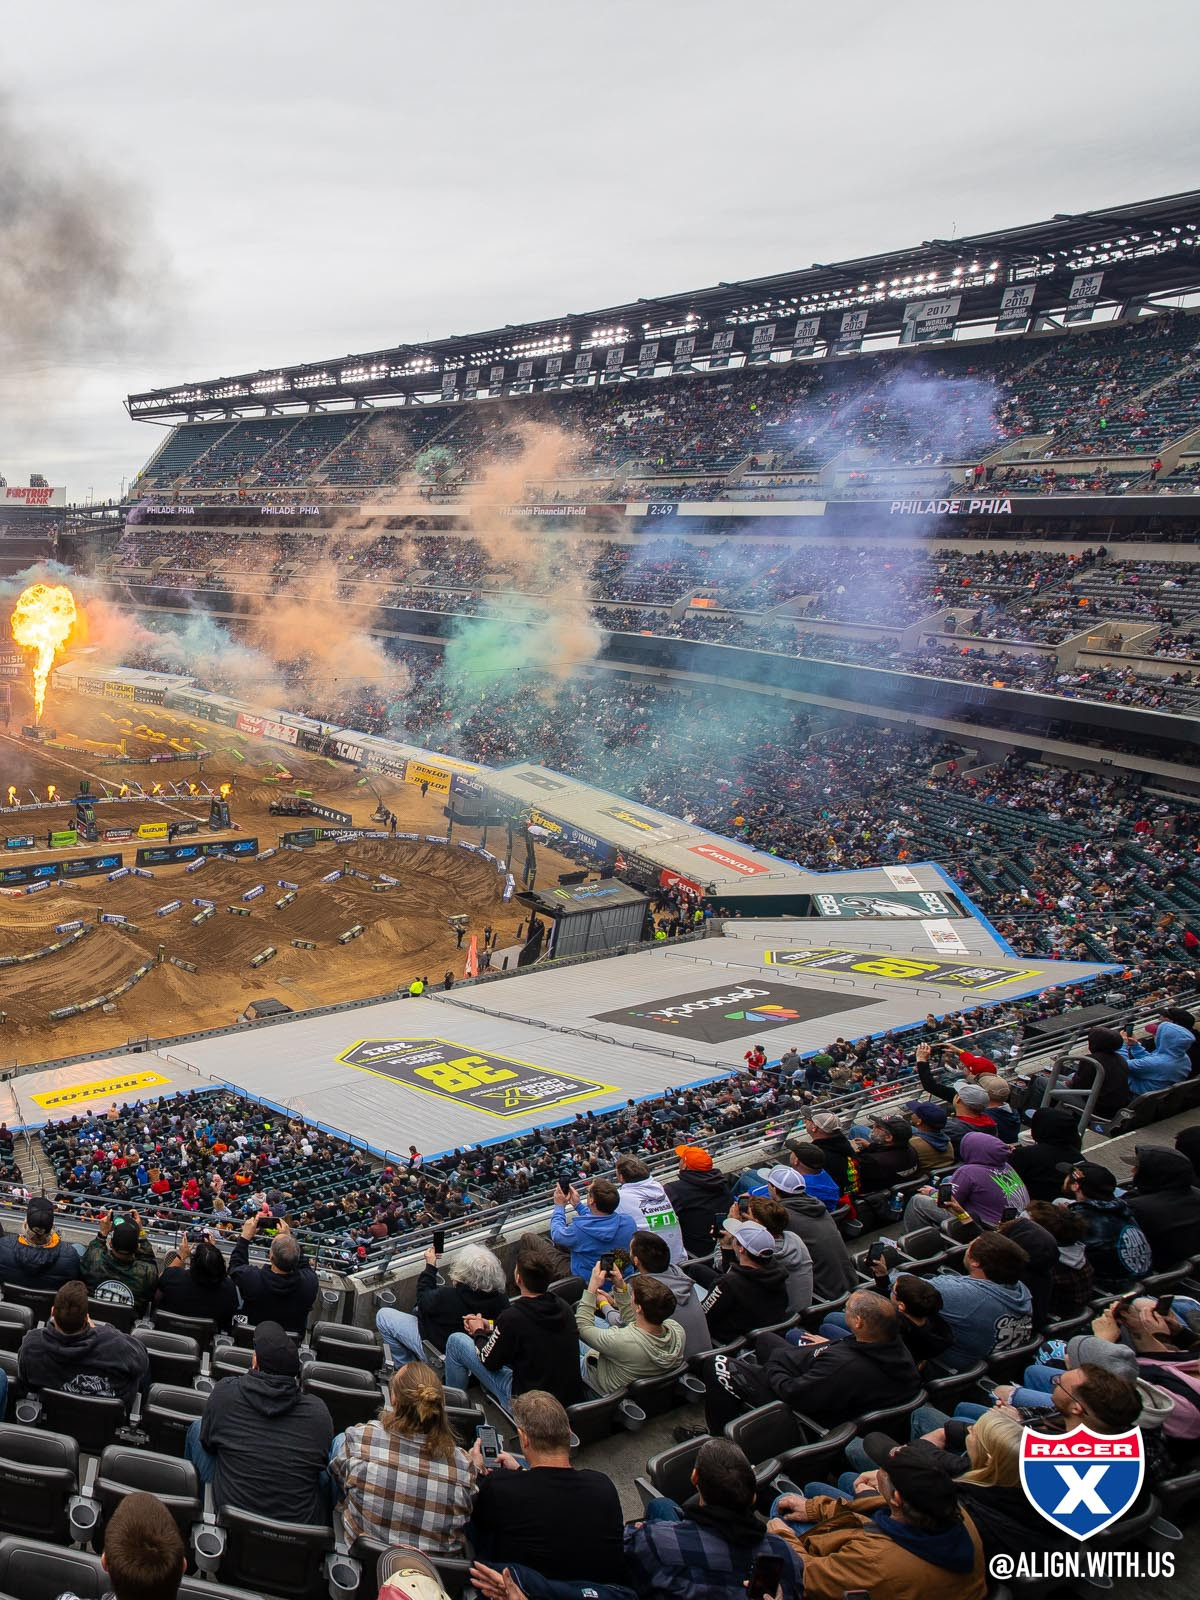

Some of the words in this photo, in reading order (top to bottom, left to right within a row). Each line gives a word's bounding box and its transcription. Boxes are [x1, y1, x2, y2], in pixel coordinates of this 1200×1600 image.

[1072, 286, 1097, 298] 2022
[1005, 296, 1029, 308] 2019
[926, 304, 952, 316] 2017
[844, 320, 863, 330] 2013
[917, 323, 953, 334] CHAMPIONS
[925, 318, 947, 326] WORLD
[533, 506, 566, 516] Financial
[567, 506, 586, 516] Field
[651, 505, 672, 515] 2:49
[106, 682, 133, 693] SUZUKI
[336, 742, 364, 762] ACME
[416, 765, 449, 778] DUNLOP
[414, 776, 448, 790] DUNLOP
[456, 776, 484, 792] FALKEN
[324, 830, 364, 838] MONSTER
[578, 832, 597, 848] YAMAHA
[710, 852, 755, 874] HONDA
[850, 957, 941, 978] 18
[649, 986, 770, 1018] peacock
[362, 1042, 413, 1056] 2023
[413, 1055, 518, 1093] 38
[46, 1080, 138, 1104] DUNLOP
